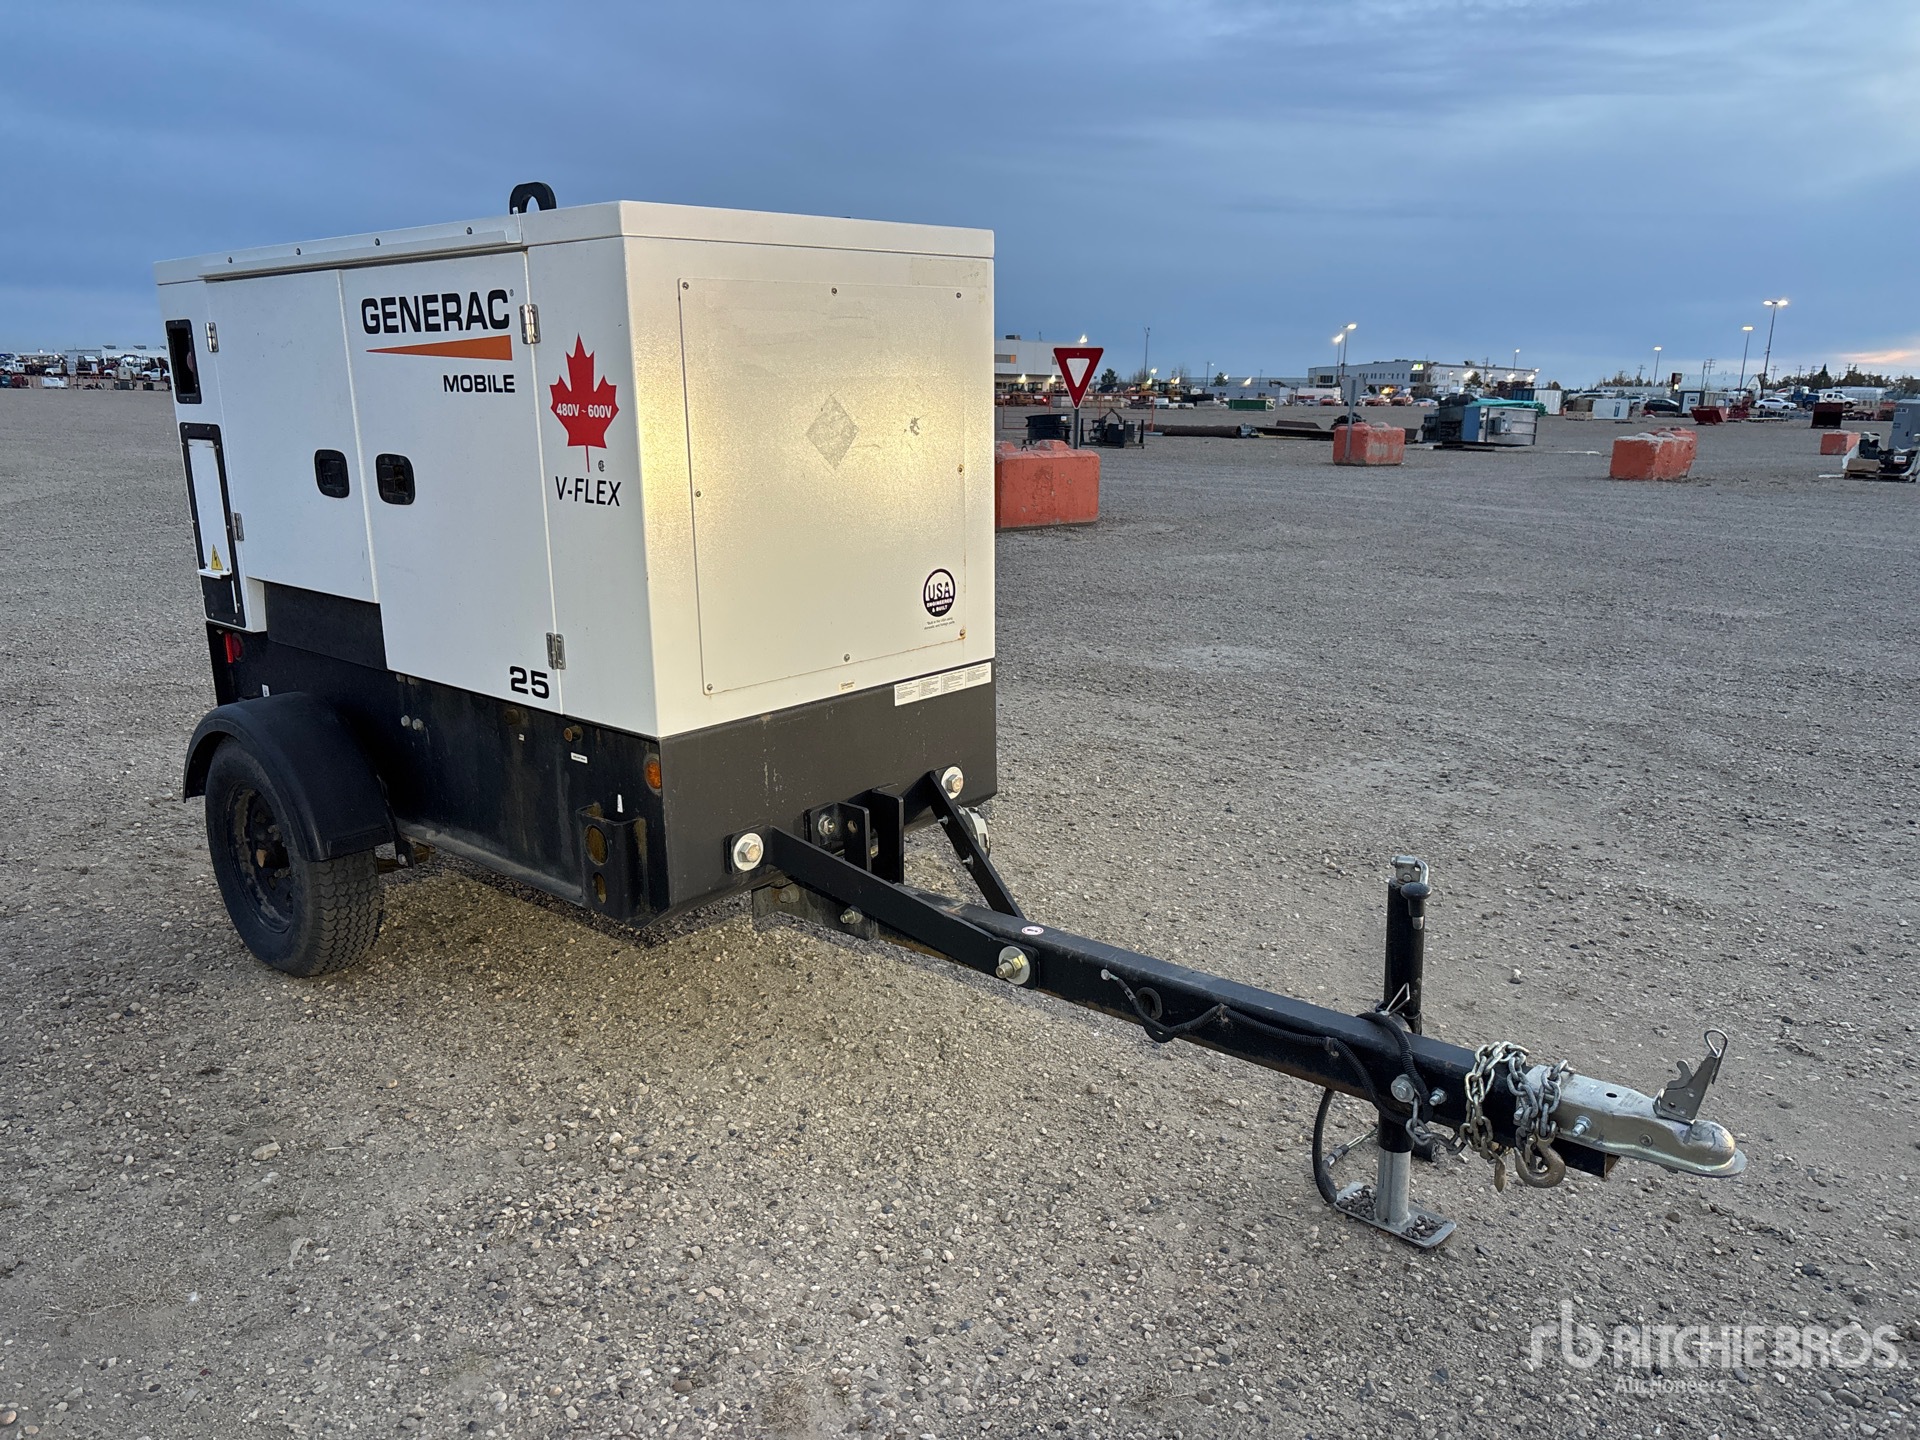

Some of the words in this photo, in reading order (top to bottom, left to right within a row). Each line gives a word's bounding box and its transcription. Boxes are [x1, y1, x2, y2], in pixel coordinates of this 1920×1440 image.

[361, 289, 510, 334] GENERAC
[443, 374, 515, 393] MOBILE
[556, 403, 580, 417] 480V
[587, 404, 612, 419] 600V
[555, 476, 621, 507] V-FLEX
[928, 581, 951, 599] USA
[509, 666, 550, 699] 25
